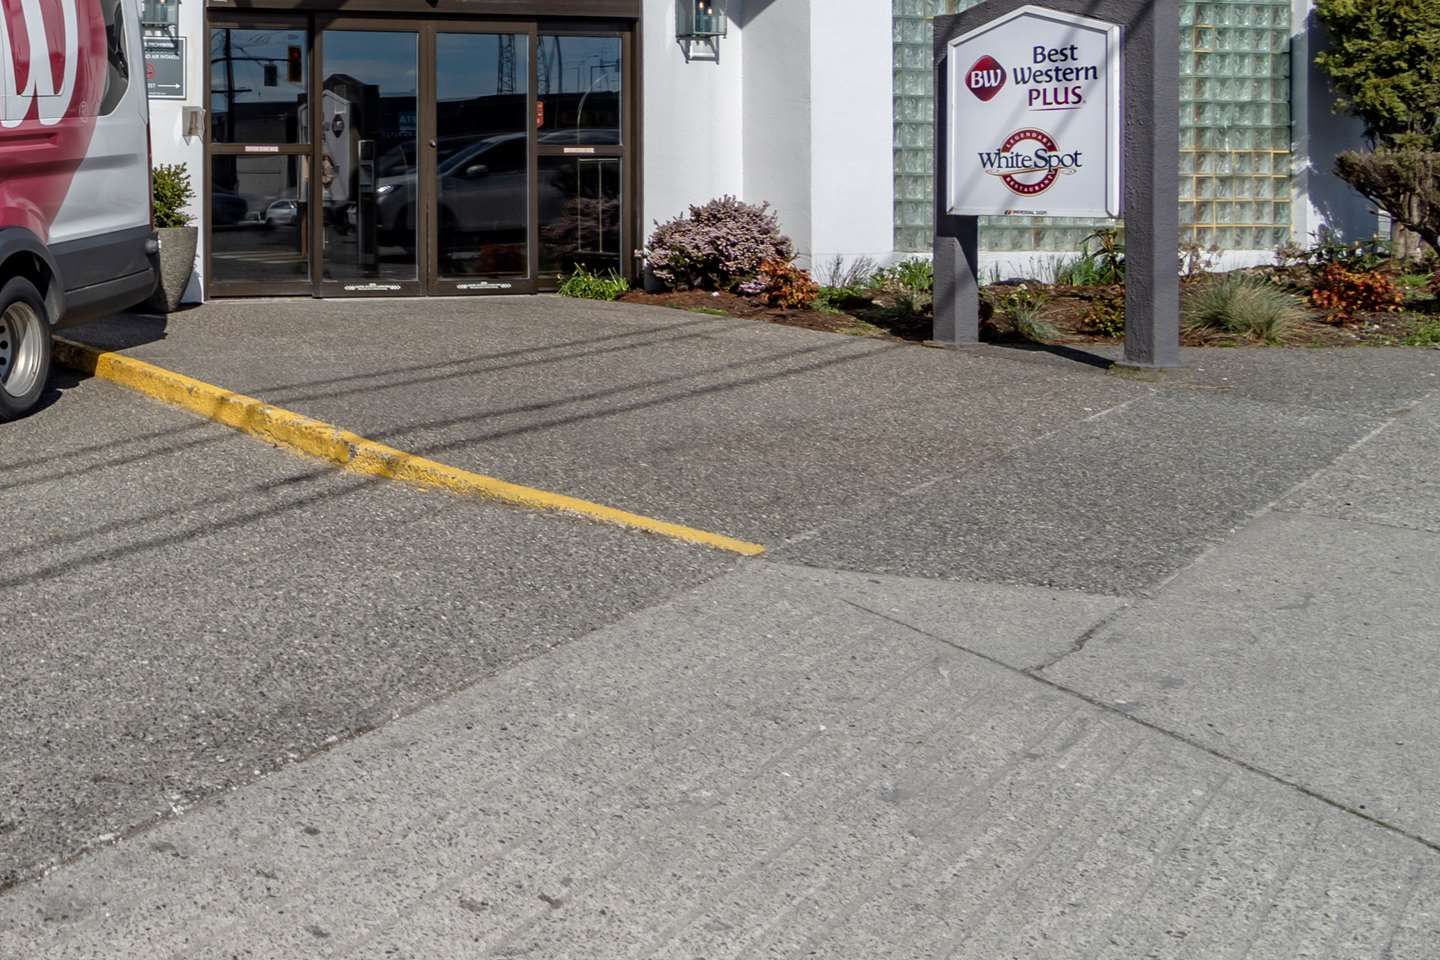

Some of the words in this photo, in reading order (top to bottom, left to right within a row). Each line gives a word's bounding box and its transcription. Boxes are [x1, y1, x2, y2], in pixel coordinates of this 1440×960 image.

[1032, 44, 1078, 64] Best
[970, 70, 1002, 89] BW
[1013, 65, 1098, 85] Western
[1028, 86, 1083, 106] PLUS
